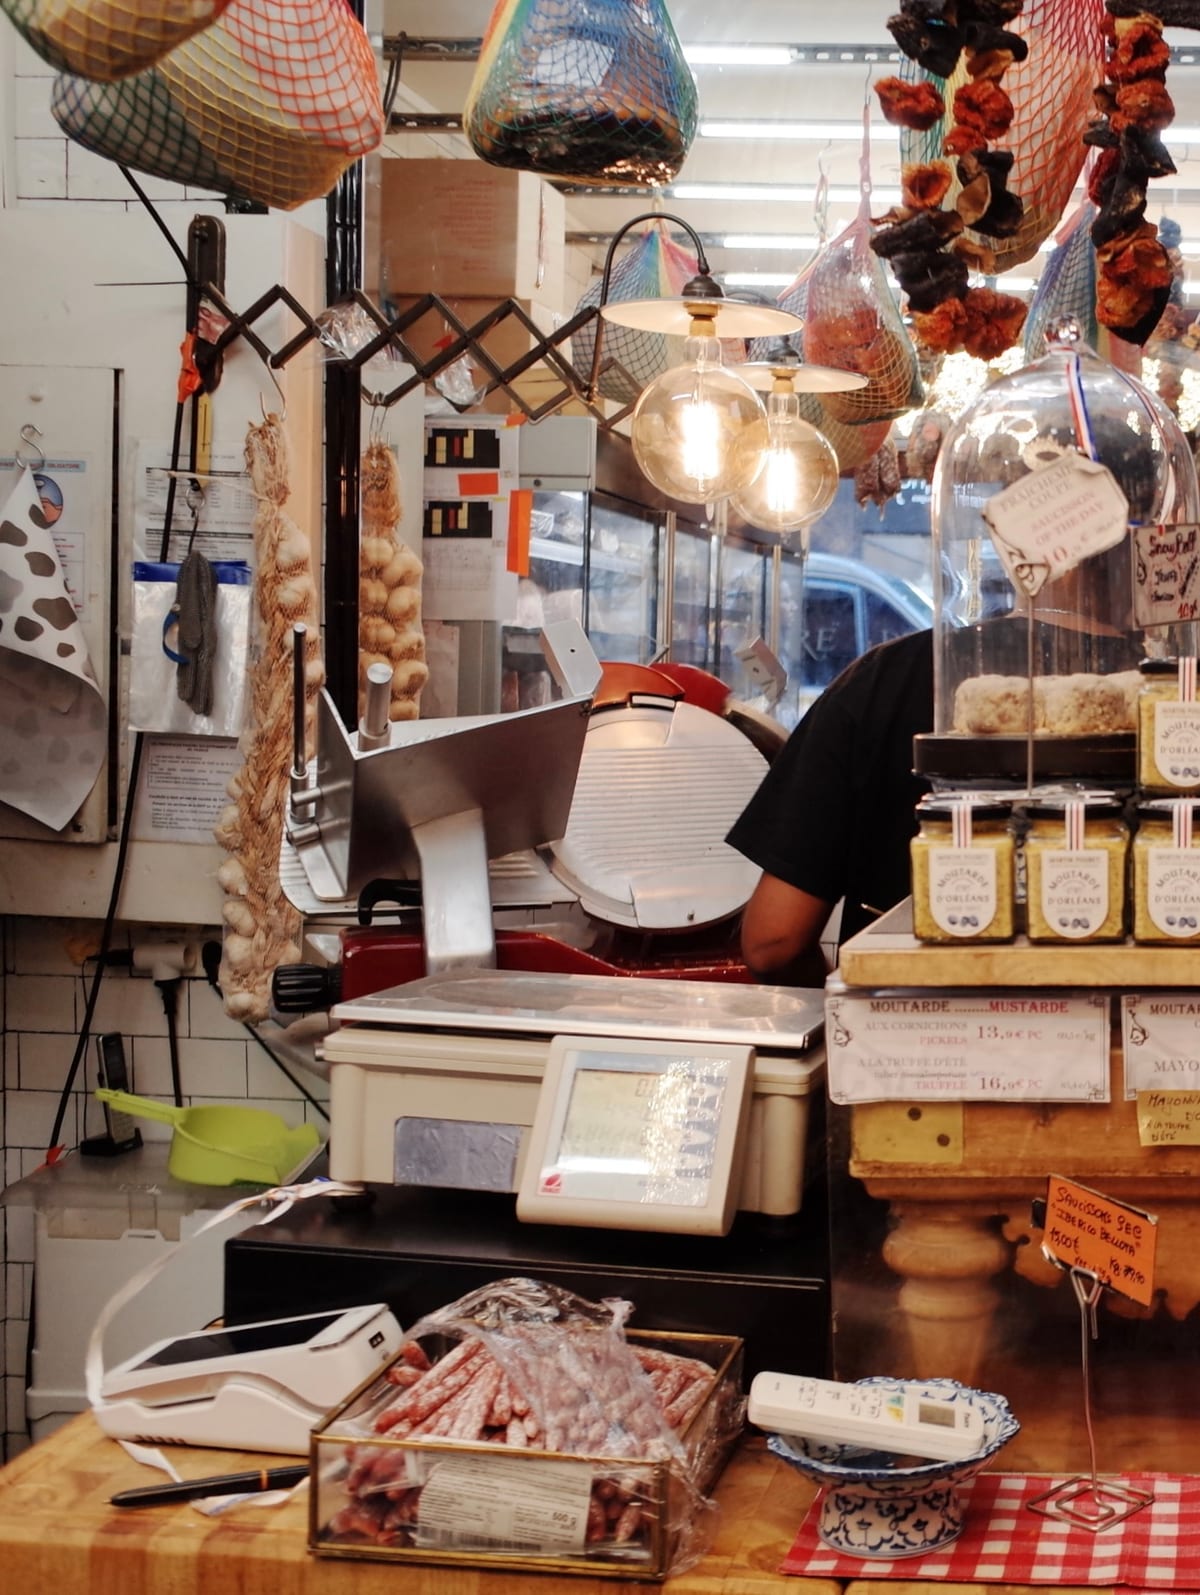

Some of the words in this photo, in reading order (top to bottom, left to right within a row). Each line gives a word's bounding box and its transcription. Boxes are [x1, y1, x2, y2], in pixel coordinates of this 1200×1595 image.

[870, 1001, 950, 1013] MOUTARDE
[989, 1001, 1069, 1013] MUSTARDE
[864, 1021, 889, 1031] AUX
[891, 1021, 968, 1031] CORNICHONS
[886, 1057, 931, 1067] TRUFFE
